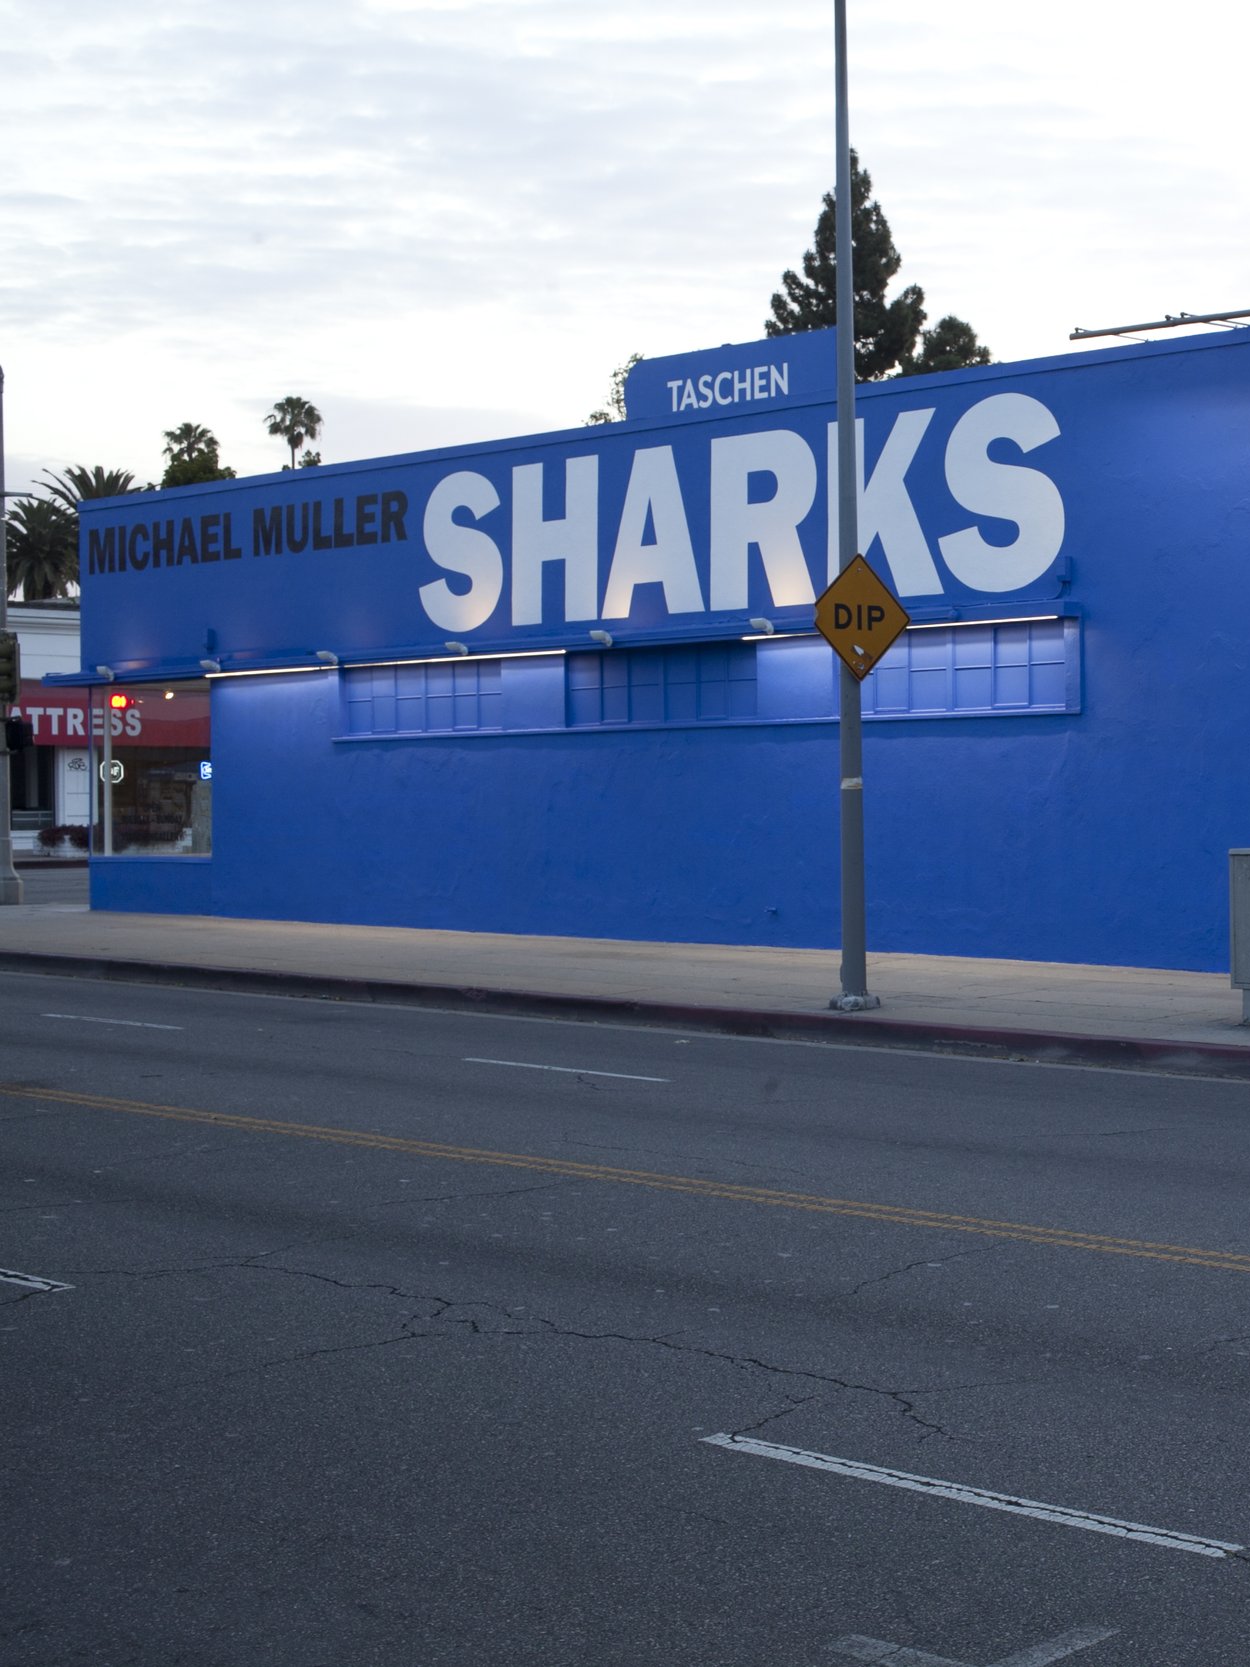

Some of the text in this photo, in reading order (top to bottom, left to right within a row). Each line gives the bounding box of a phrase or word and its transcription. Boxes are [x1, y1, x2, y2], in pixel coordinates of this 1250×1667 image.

[667, 362, 789, 412] TASCHEN
[88, 491, 408, 575] MICHAEL MULLER
[419, 393, 1065, 633] SHARKS
[834, 603, 885, 631] DIP
